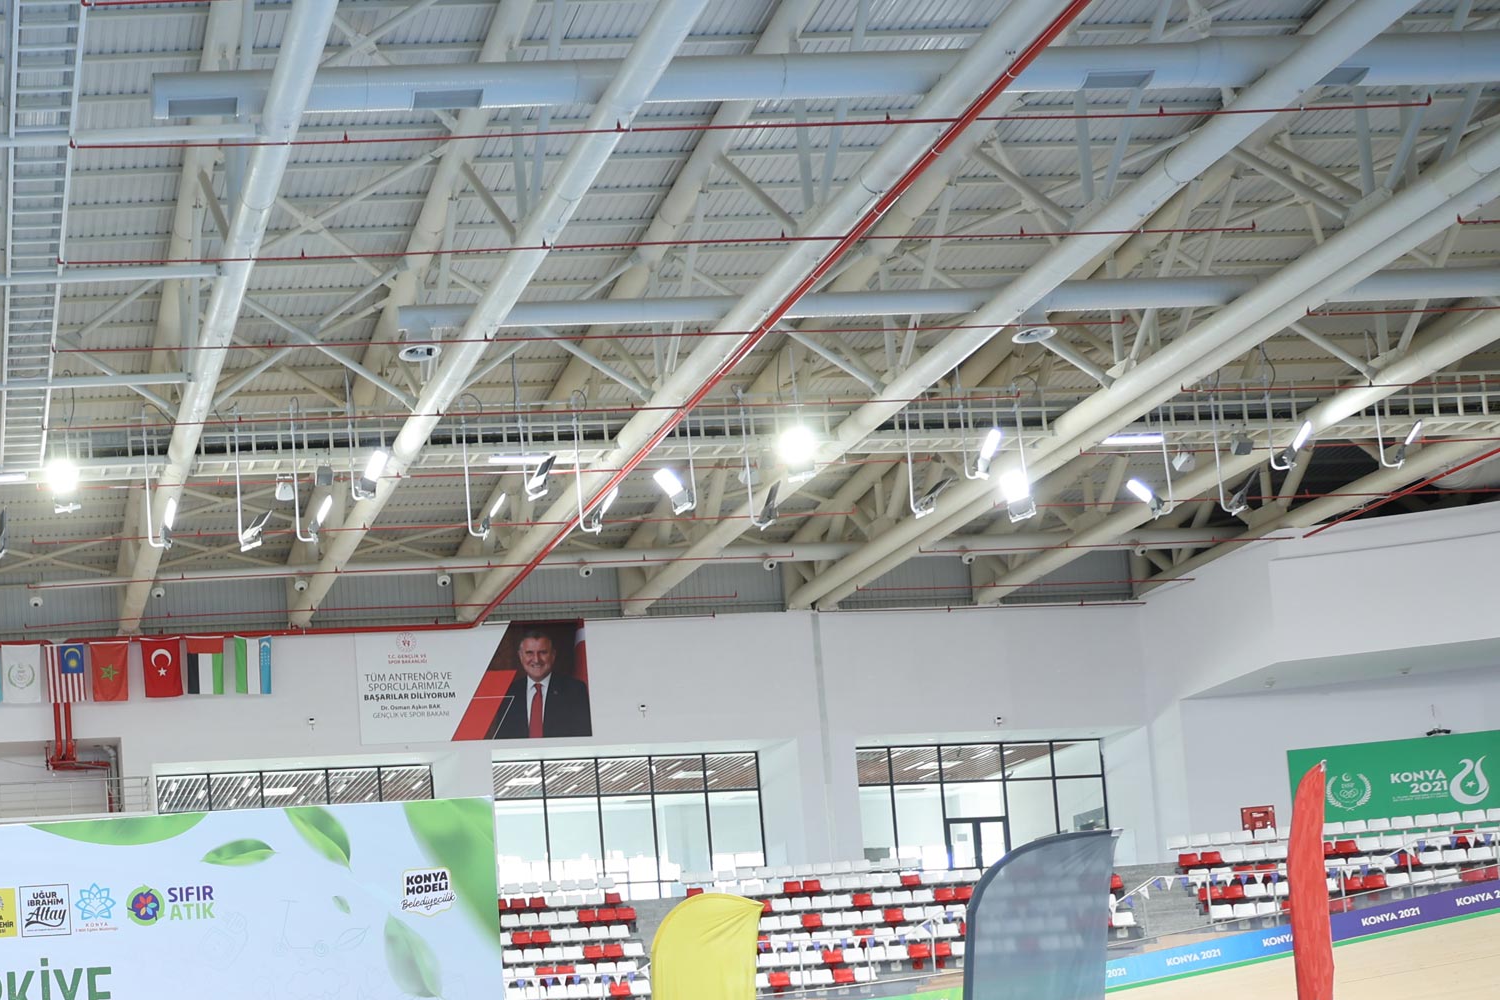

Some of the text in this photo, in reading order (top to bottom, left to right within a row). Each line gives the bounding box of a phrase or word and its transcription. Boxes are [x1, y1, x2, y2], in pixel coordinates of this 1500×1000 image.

[365, 671, 452, 682] TÜM ANTRENÖR VE
[368, 681, 450, 692] SPORCULARIMIZA
[364, 691, 456, 702] BAŞARILAR DİLİYORUM
[1390, 769, 1446, 784] KONYA
[1410, 780, 1448, 794] 2021
[406, 871, 448, 885] KONYA
[32, 890, 57, 899] UĞUR
[168, 885, 214, 902] SIFIR
[1455, 891, 1491, 907] KONYA
[25, 906, 67, 925] Altay
[170, 902, 215, 920] ATIK
[1361, 906, 1421, 926] KONYA 2021
[1166, 948, 1222, 967] KONYA 2021
[1107, 967, 1127, 979] 2021
